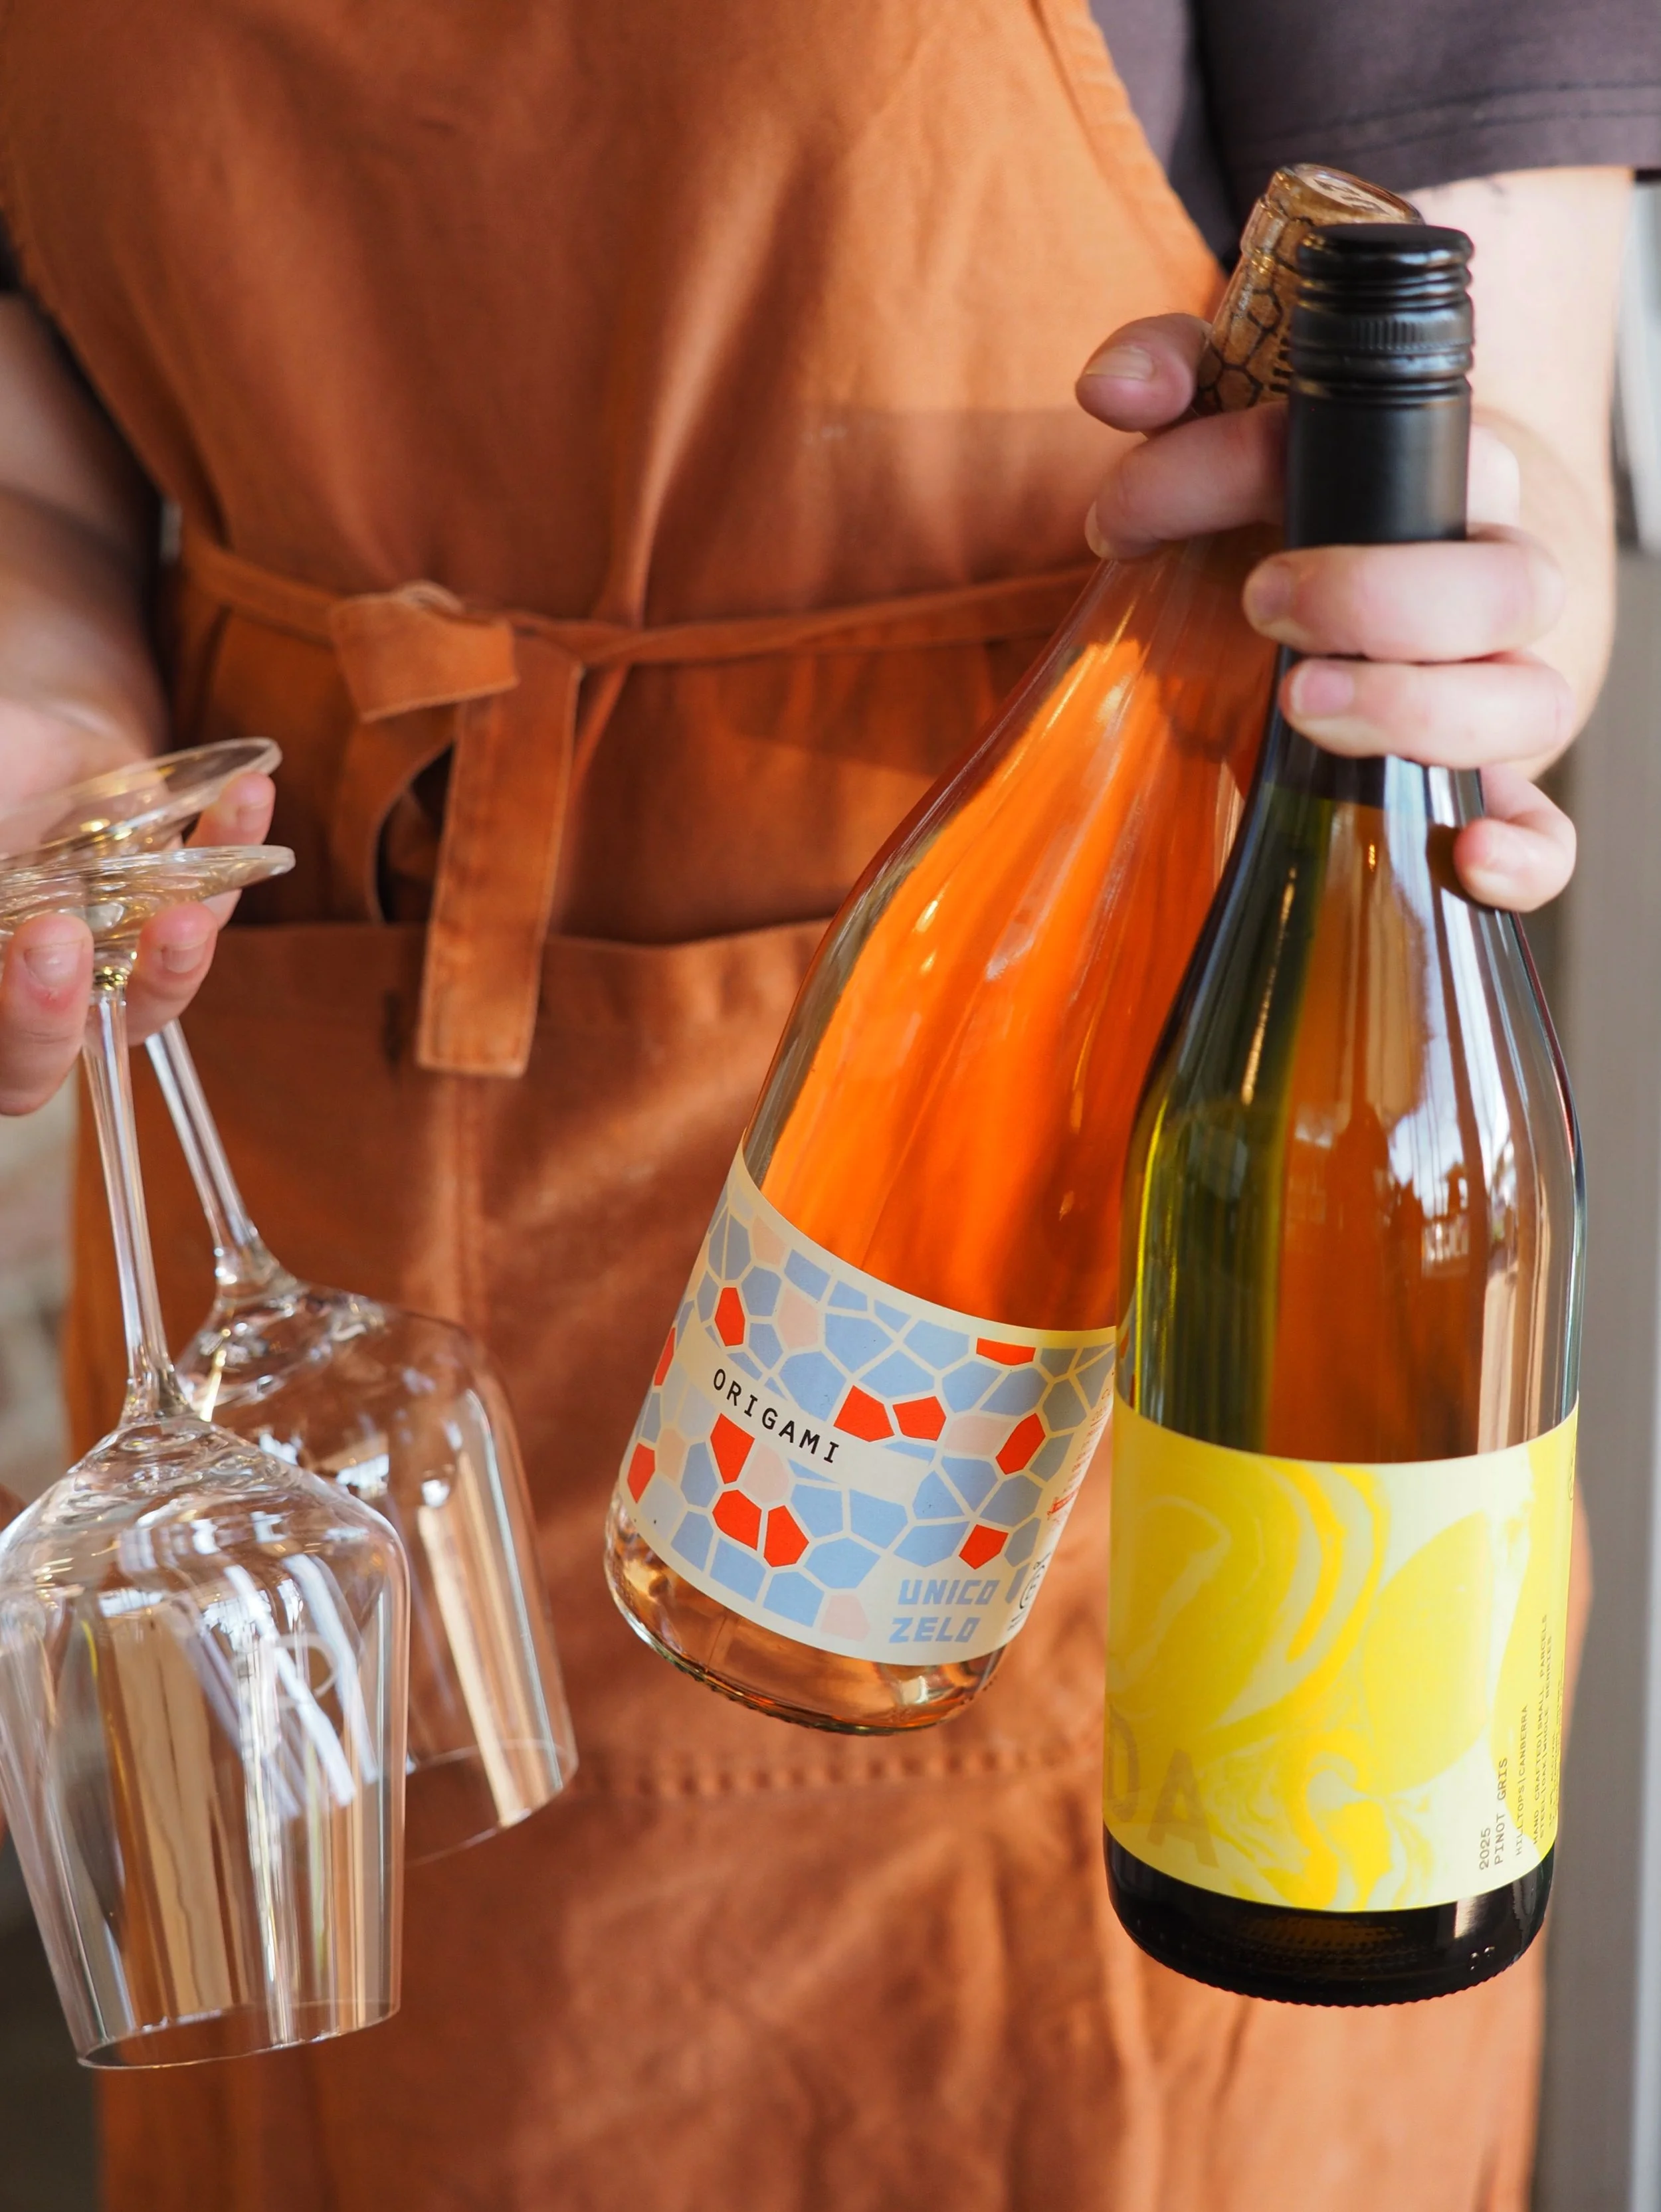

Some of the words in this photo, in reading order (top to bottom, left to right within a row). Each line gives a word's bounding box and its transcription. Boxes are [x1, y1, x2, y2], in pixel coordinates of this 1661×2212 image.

[713, 1368, 839, 1463] ORIGAMI
[898, 1579, 1001, 1605] UNICO
[888, 1616, 981, 1643] ZELO
[1497, 1757, 1508, 1801] GRIS
[1479, 1827, 1492, 1871] 2025
[1494, 1812, 1506, 1865] PINOT
